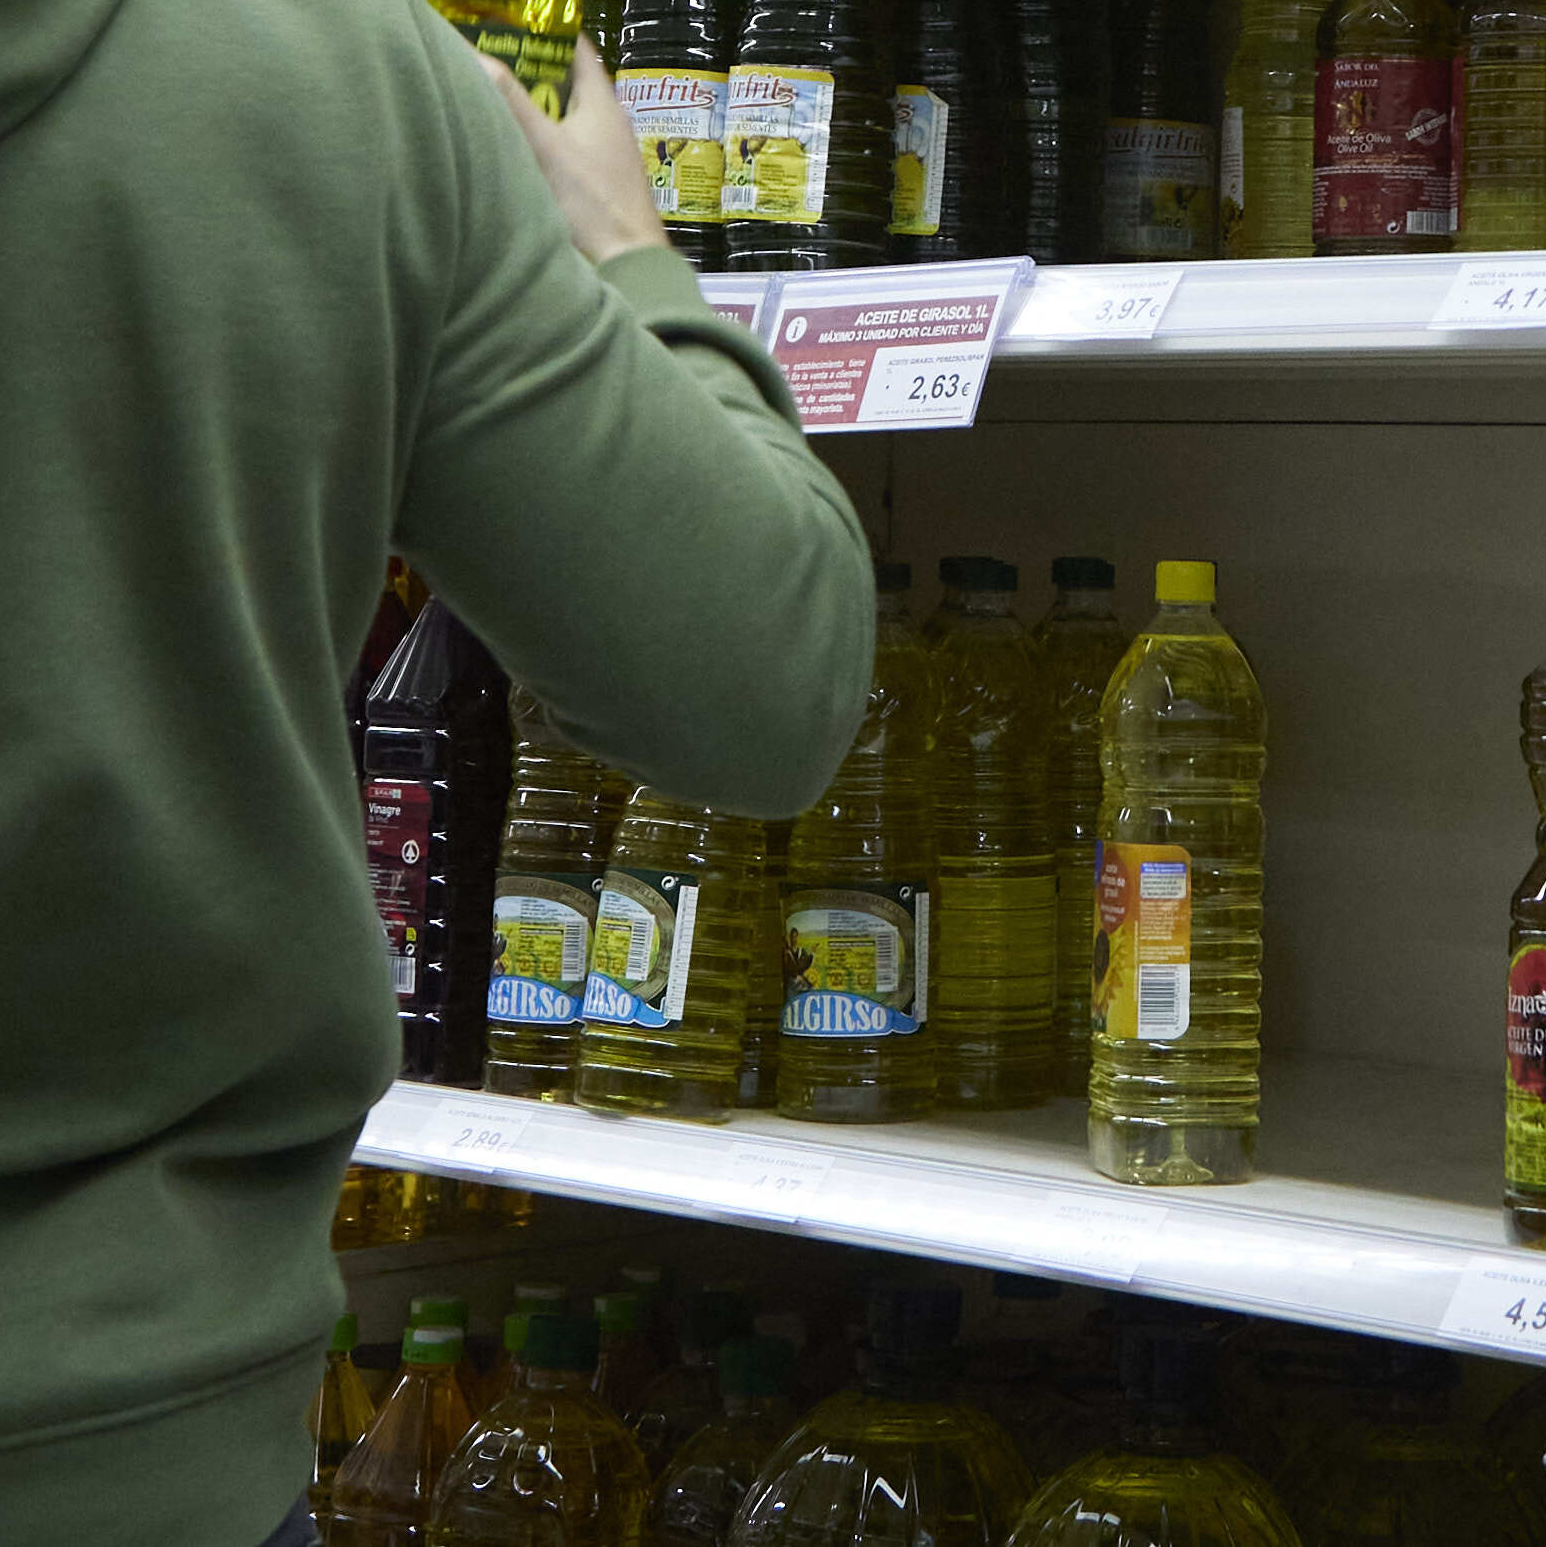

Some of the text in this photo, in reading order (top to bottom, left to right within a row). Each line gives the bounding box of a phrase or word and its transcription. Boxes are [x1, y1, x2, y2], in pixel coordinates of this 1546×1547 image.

[1366, 132, 1391, 143] Oliva
[1337, 142, 1373, 154] Olive Oil
[854, 304, 988, 327] ACEITE DE GIRASOL 1L
[818, 321, 984, 344] MÁXIMO 3 UNIDAD POR CLIENTE Y DÍA
[368, 802, 401, 817] Vinagre
